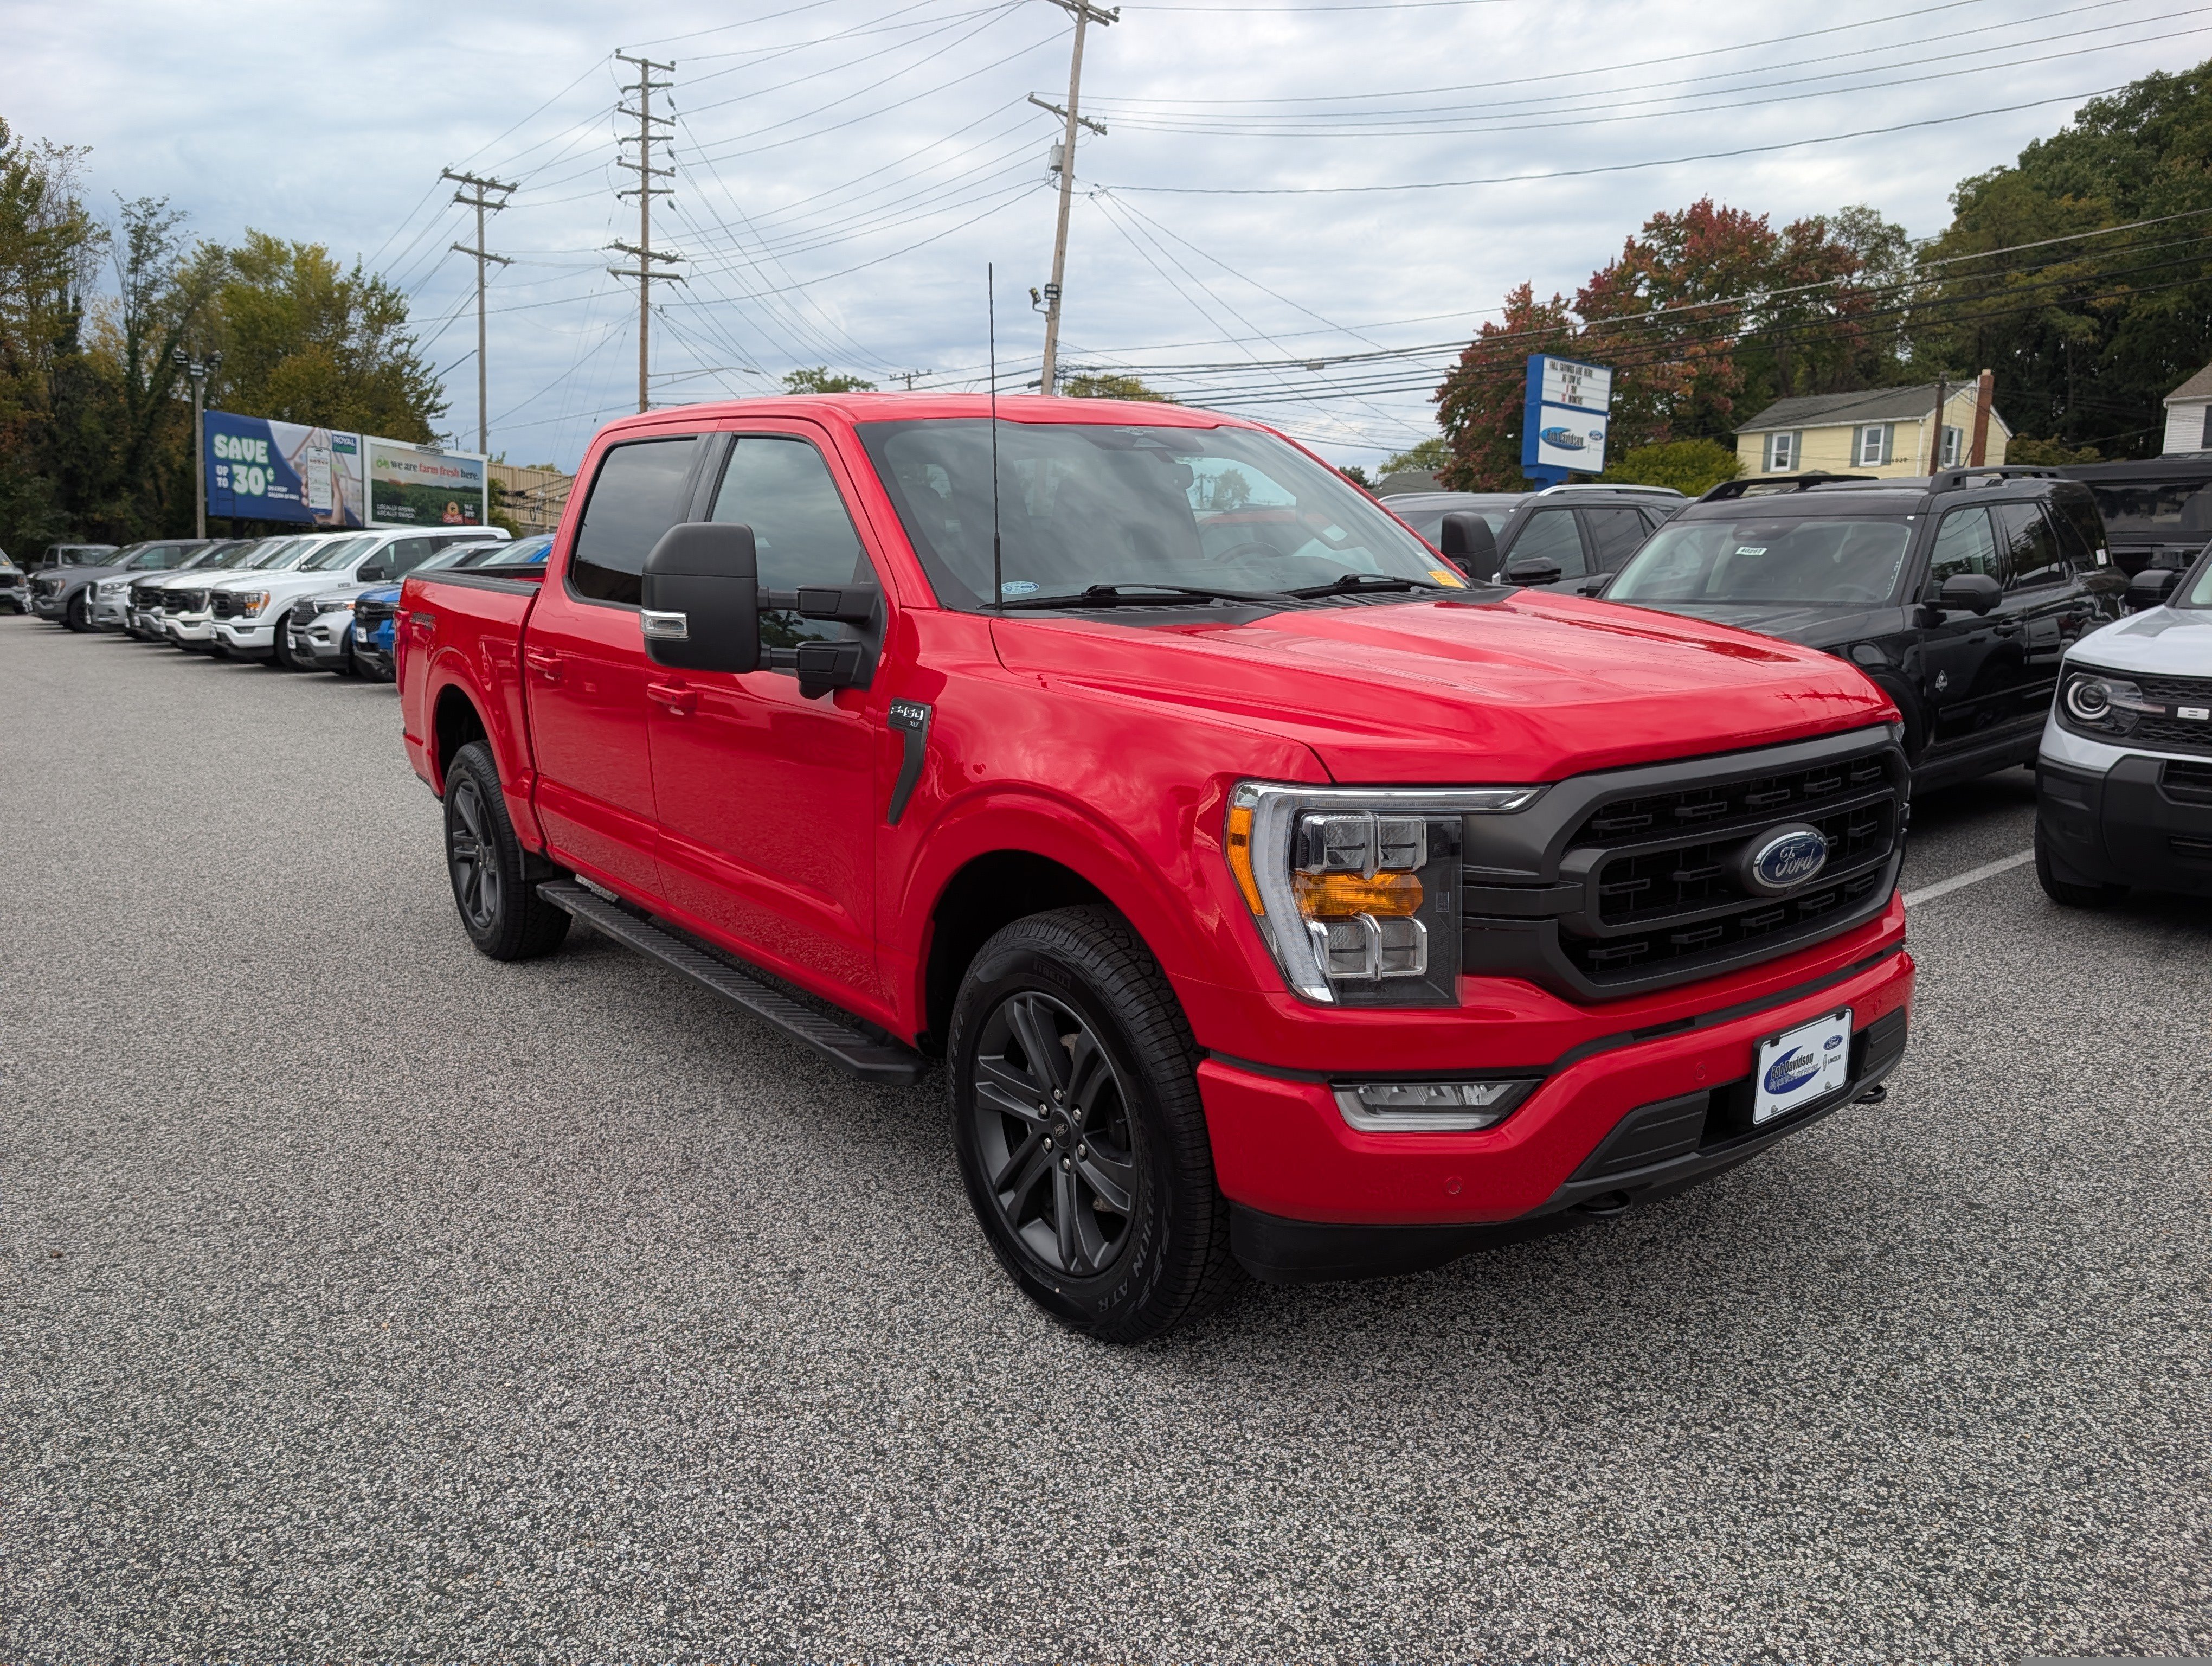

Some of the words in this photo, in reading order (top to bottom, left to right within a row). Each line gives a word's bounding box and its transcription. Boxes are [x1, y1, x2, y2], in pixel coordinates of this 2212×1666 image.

[1549, 361, 1558, 371] FALL
[333, 435, 356, 446] ROYAL
[1559, 432, 1584, 446] Davidson
[214, 434, 269, 464] SAVE
[216, 464, 229, 476] UP
[390, 460, 403, 470] we
[404, 462, 418, 472] are
[419, 462, 439, 475] farm
[440, 465, 460, 478] fresh
[461, 468, 480, 480] here.
[216, 476, 229, 488] TO
[1775, 844, 1815, 877] Ford
[1771, 1062, 1785, 1079] Bob
[1785, 1052, 1814, 1074] Davidson
[1828, 1054, 1842, 1064] LINCOLN
